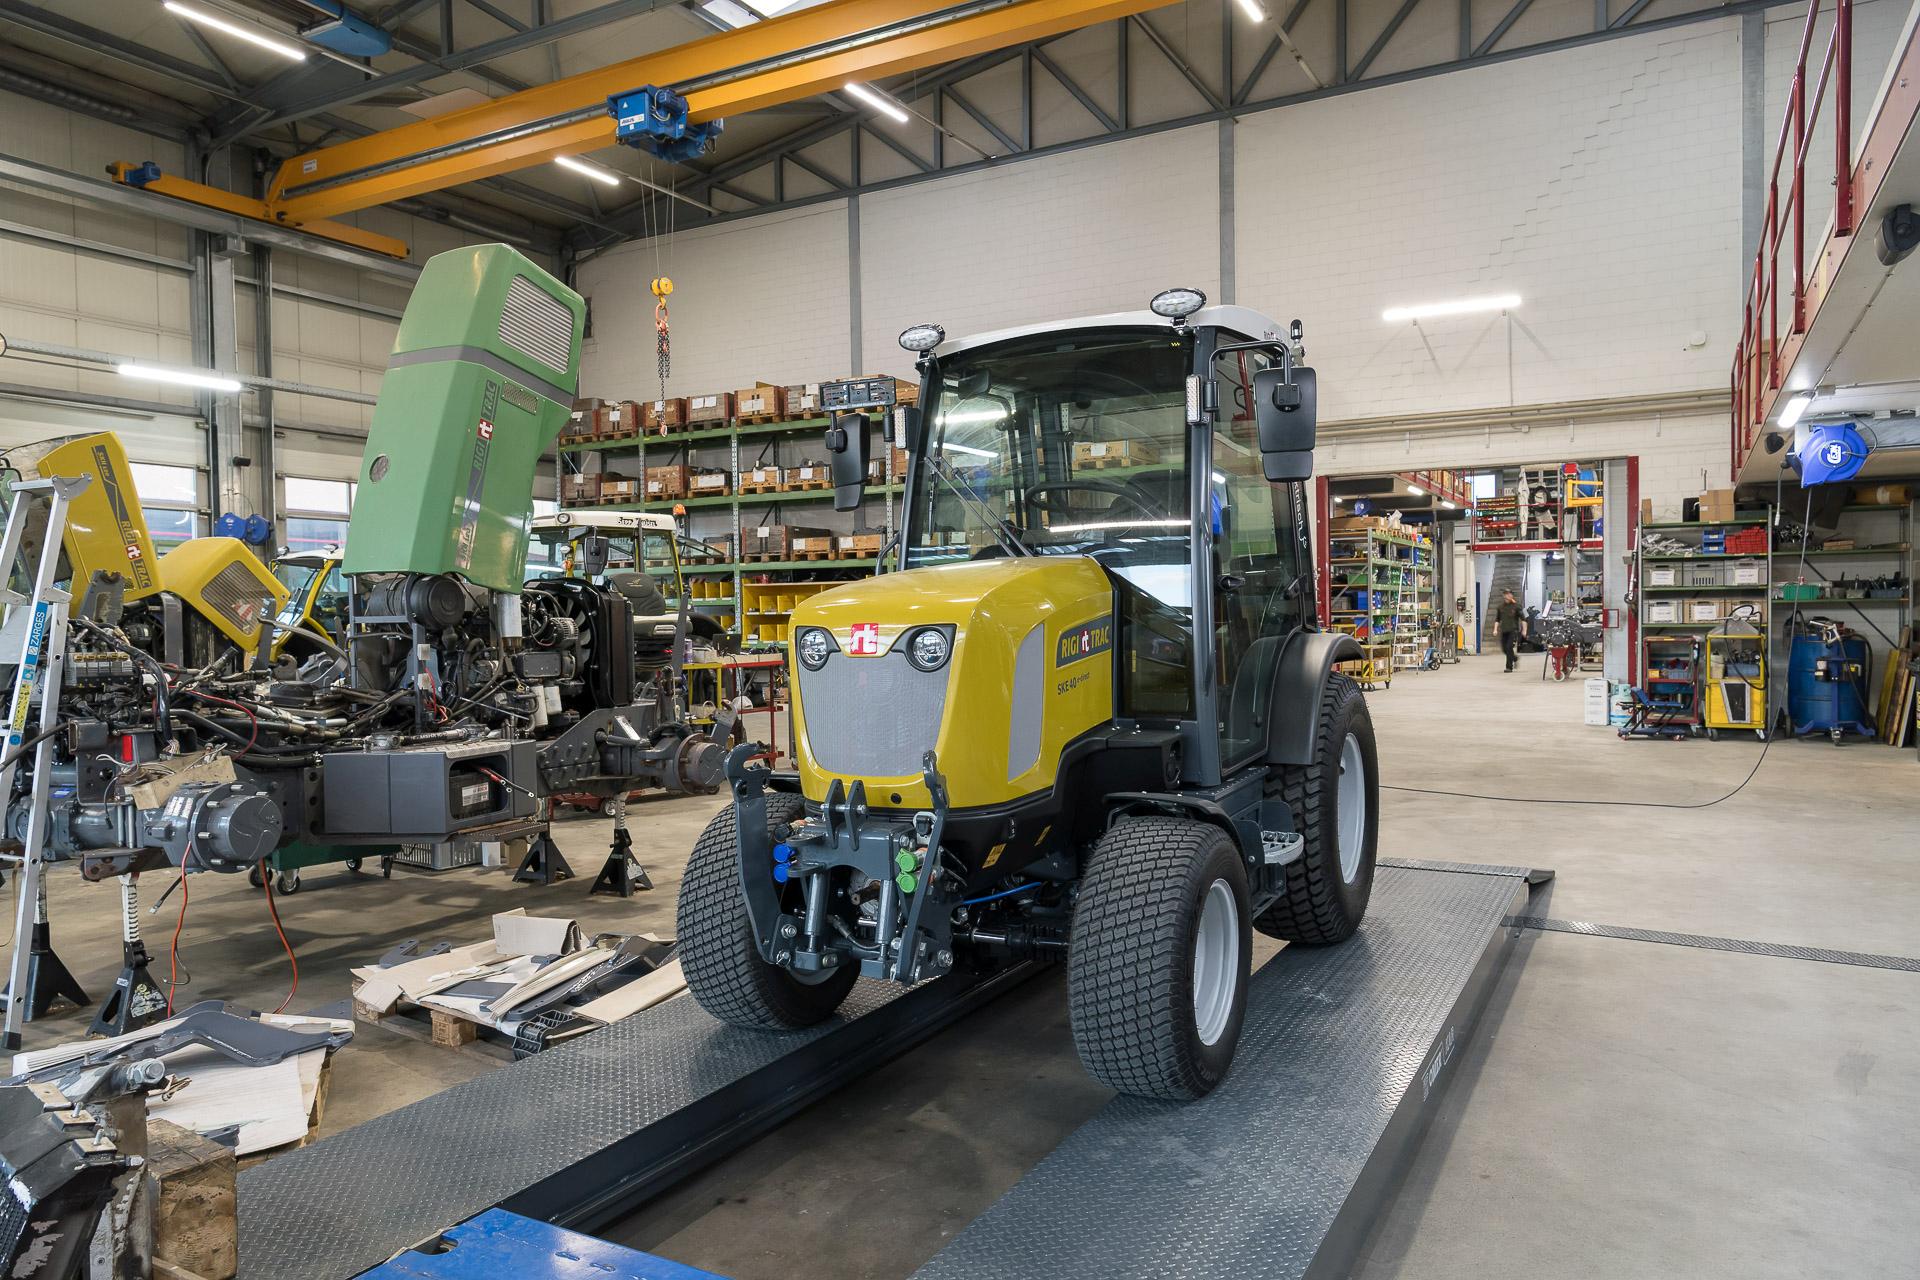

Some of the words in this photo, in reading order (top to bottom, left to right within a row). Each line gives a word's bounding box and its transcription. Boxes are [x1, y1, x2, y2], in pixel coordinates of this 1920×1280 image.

[473, 440, 488, 469] RIGI
[482, 381, 496, 417] TRAC
[121, 520, 136, 543] RIGI
[136, 561, 151, 587] TRAC
[30, 611, 45, 646] ZARGES
[1061, 635, 1079, 659] RIGI
[1090, 625, 1109, 649] TRAC
[1057, 680, 1069, 695] SKE
[1070, 677, 1077, 688] 40
